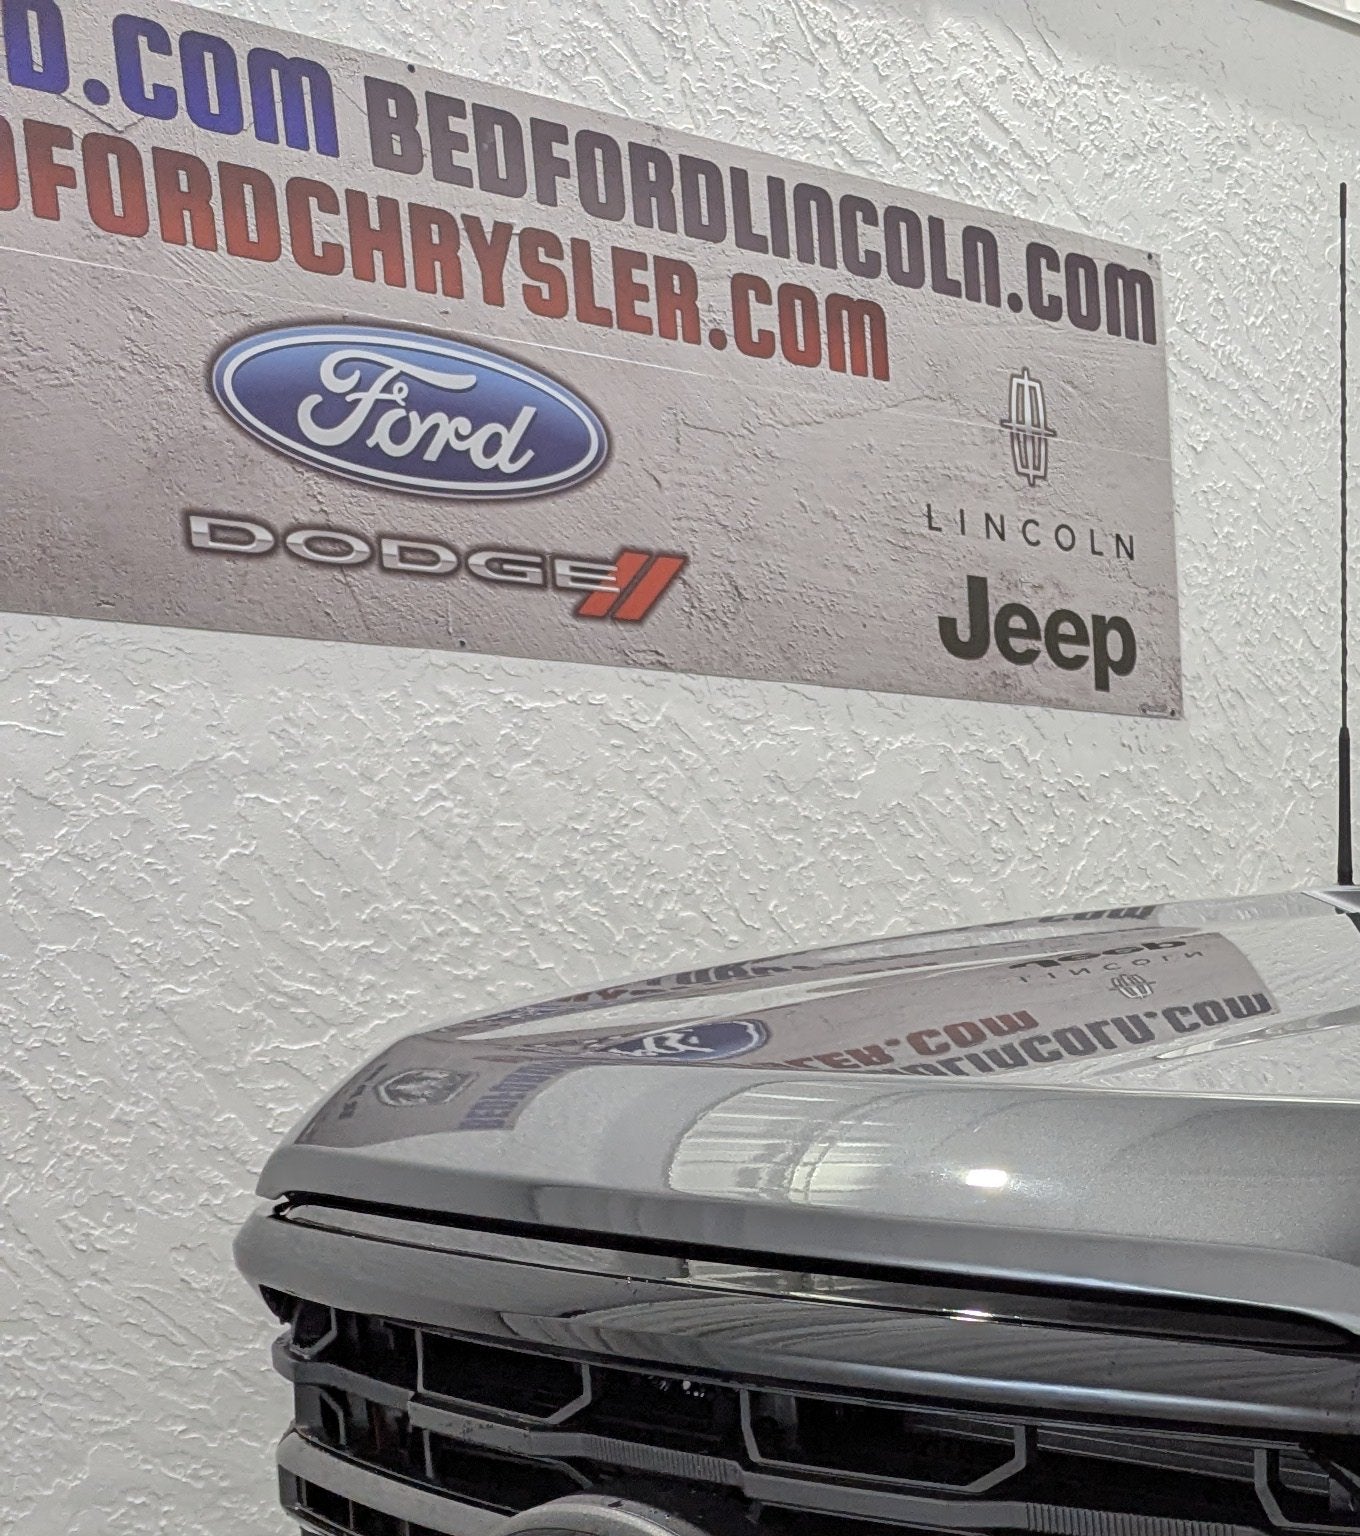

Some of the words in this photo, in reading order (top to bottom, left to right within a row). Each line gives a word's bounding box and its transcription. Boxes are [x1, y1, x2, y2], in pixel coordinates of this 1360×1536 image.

[363, 75, 1158, 345] BEDFORDLINCOLN.COM
[297, 348, 538, 474] Ford
[188, 514, 621, 593] DODGE
[925, 502, 1136, 561] LINCOLN
[937, 573, 1138, 693] Jeep
